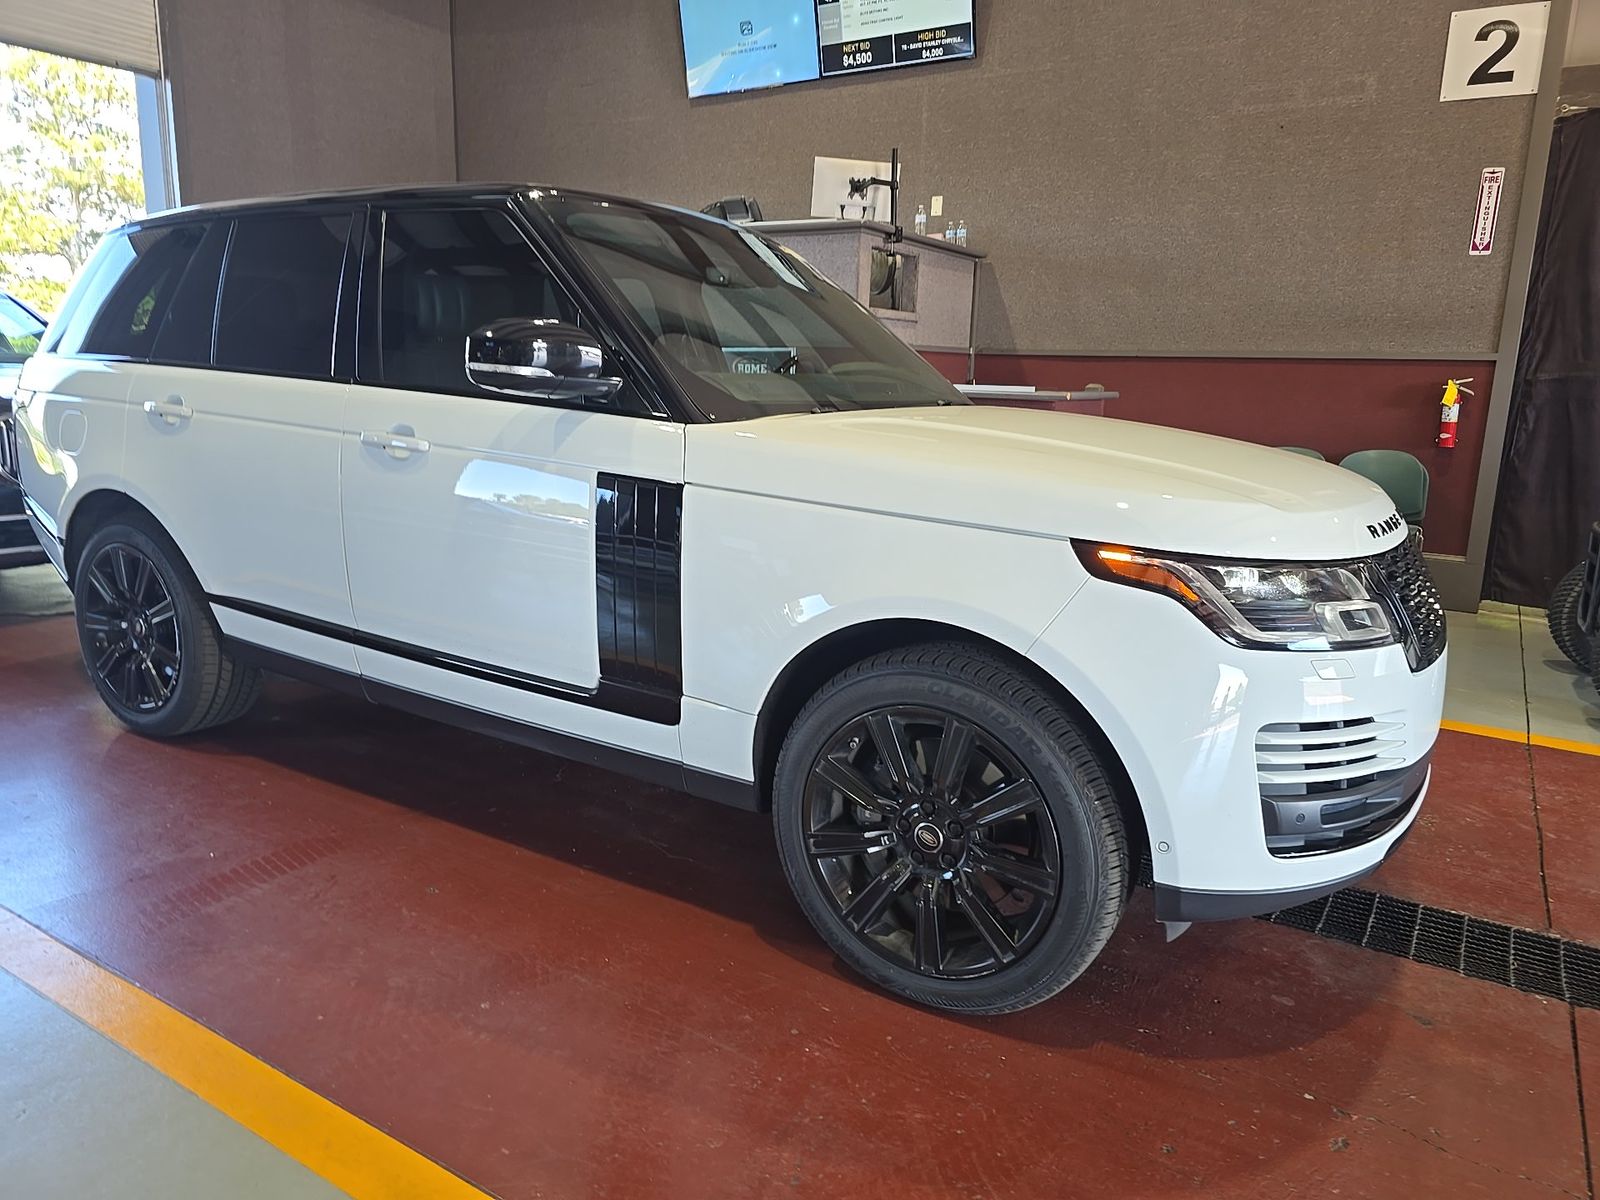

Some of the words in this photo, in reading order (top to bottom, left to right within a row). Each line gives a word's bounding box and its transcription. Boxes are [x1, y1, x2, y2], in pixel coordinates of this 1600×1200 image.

[917, 31, 934, 41] HIGH
[935, 29, 947, 39] BID
[843, 42, 859, 53] NEXT
[859, 41, 871, 51] BID
[1466, 19, 1520, 86] 2
[1483, 175, 1500, 184] FIRE
[1478, 185, 1494, 247] EXTINGUISHER
[1366, 513, 1402, 539] RANGE
